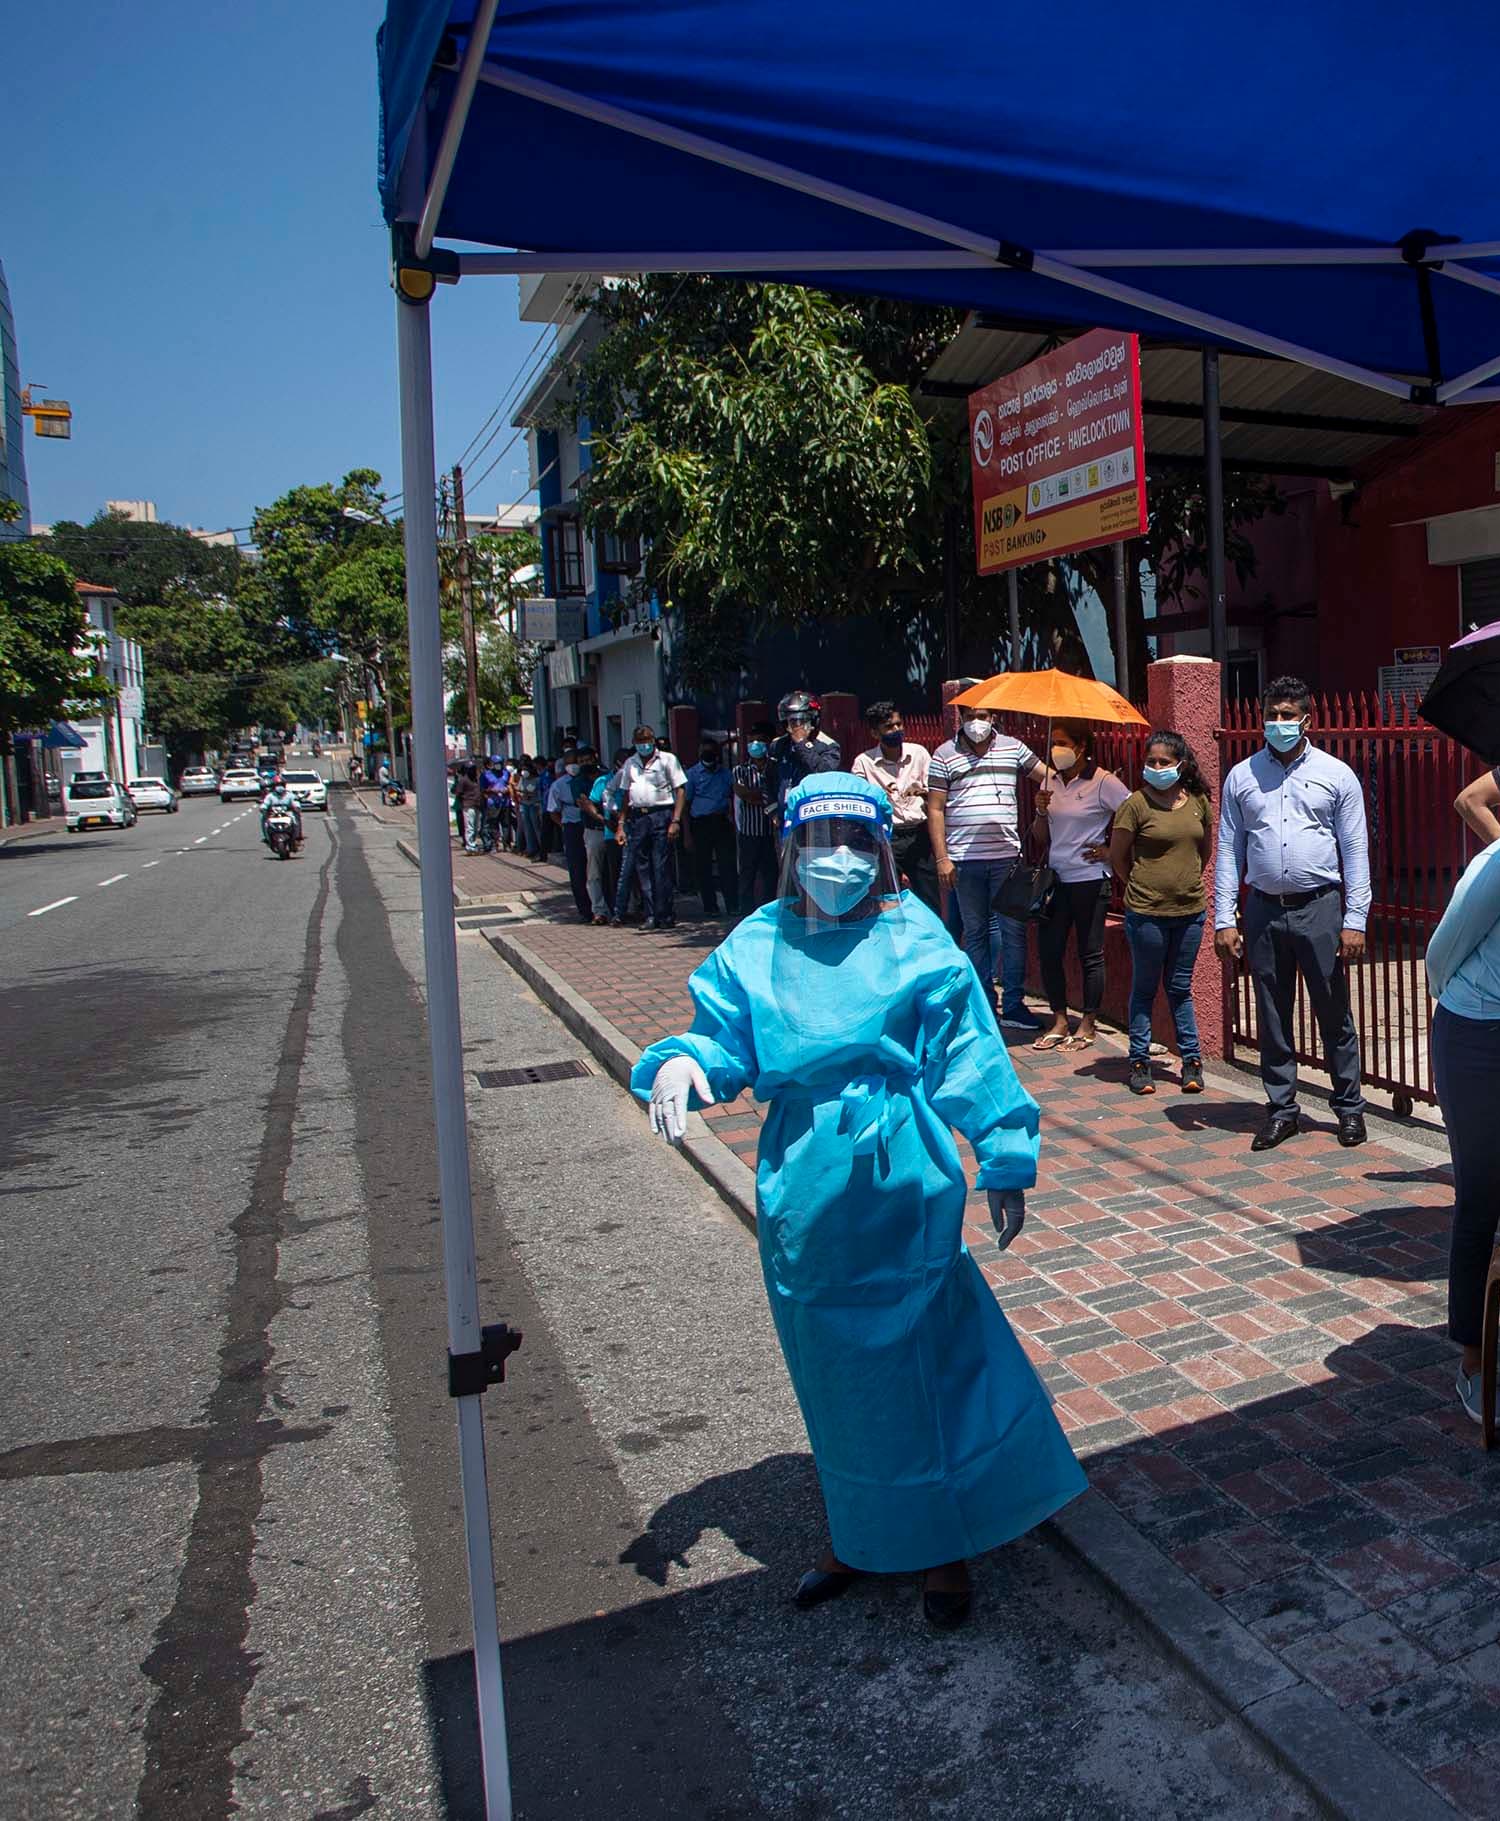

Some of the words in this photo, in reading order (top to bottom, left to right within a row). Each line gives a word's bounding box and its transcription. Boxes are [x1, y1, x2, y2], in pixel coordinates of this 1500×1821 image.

[1000, 452, 1024, 477] POST
[1026, 437, 1061, 467] OFFICE
[983, 506, 1003, 535] NSB
[983, 537, 1006, 560] POST
[803, 803, 830, 815] FACE
[833, 803, 872, 814] SHIELD
